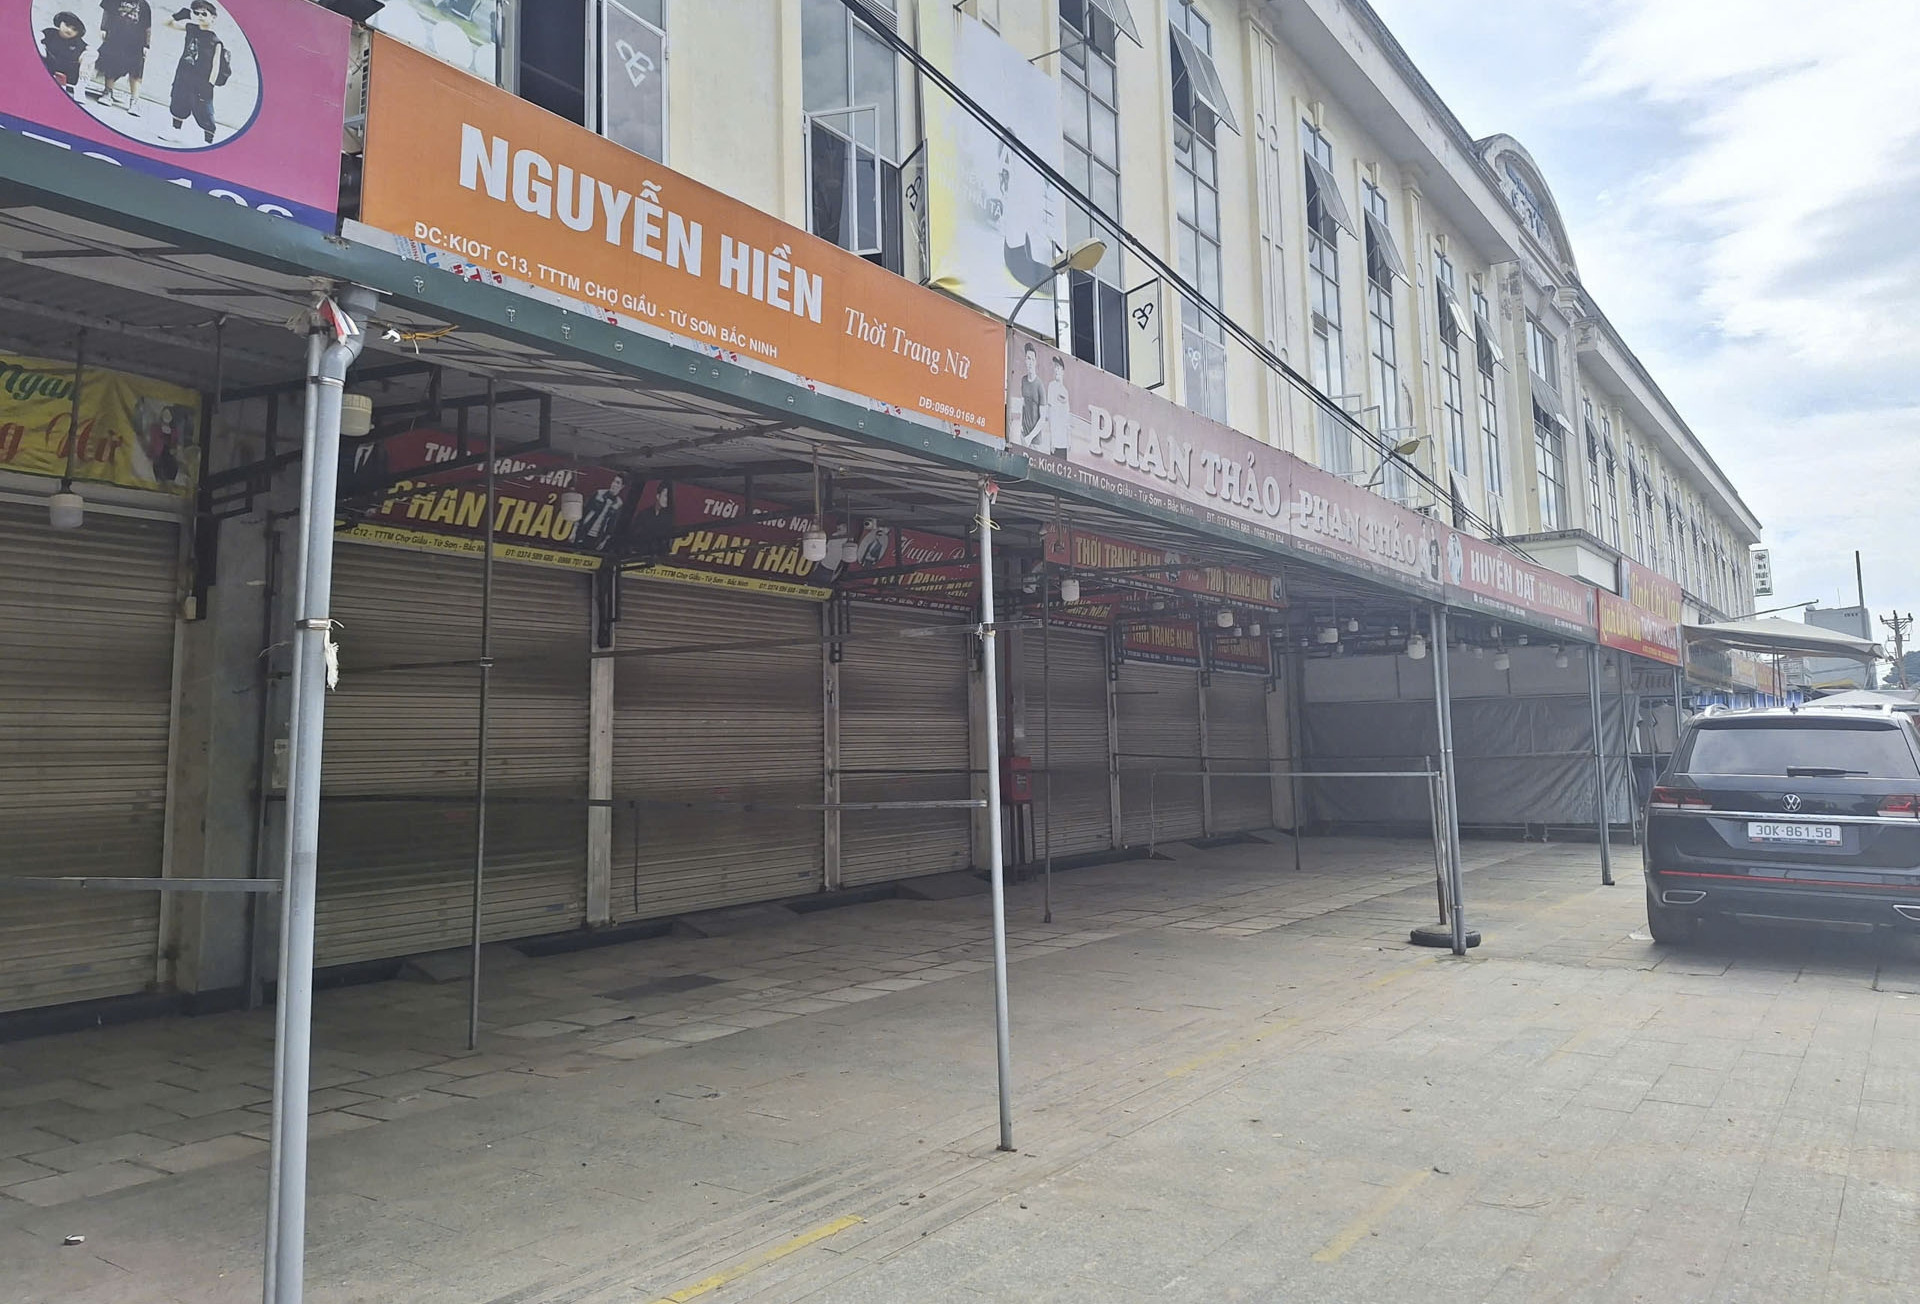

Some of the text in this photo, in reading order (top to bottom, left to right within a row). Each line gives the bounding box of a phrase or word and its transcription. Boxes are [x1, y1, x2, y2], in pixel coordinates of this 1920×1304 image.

[459, 122, 823, 324] NGUYỄN HIỀN
[496, 250, 532, 279] C13,
[537, 263, 580, 292] TTTM
[584, 280, 618, 306] CHỢ
[622, 293, 657, 318] GIẦU
[669, 309, 687, 328] TỪ
[690, 317, 717, 338] SƠN
[721, 325, 746, 348] BẮC
[749, 337, 778, 359] NINH
[844, 306, 971, 380] Thời Trang Nữ
[1038, 456, 1055, 473] Kiot
[1056, 463, 1072, 479] C12
[1078, 469, 1099, 488] TTTM
[1088, 404, 1283, 518] PHAN THẢO
[704, 498, 739, 519] THỜI
[1298, 489, 1417, 567] PHAN THẢO
[669, 530, 751, 568] PHAN
[1756, 823, 1833, 839] 30K-861.58
